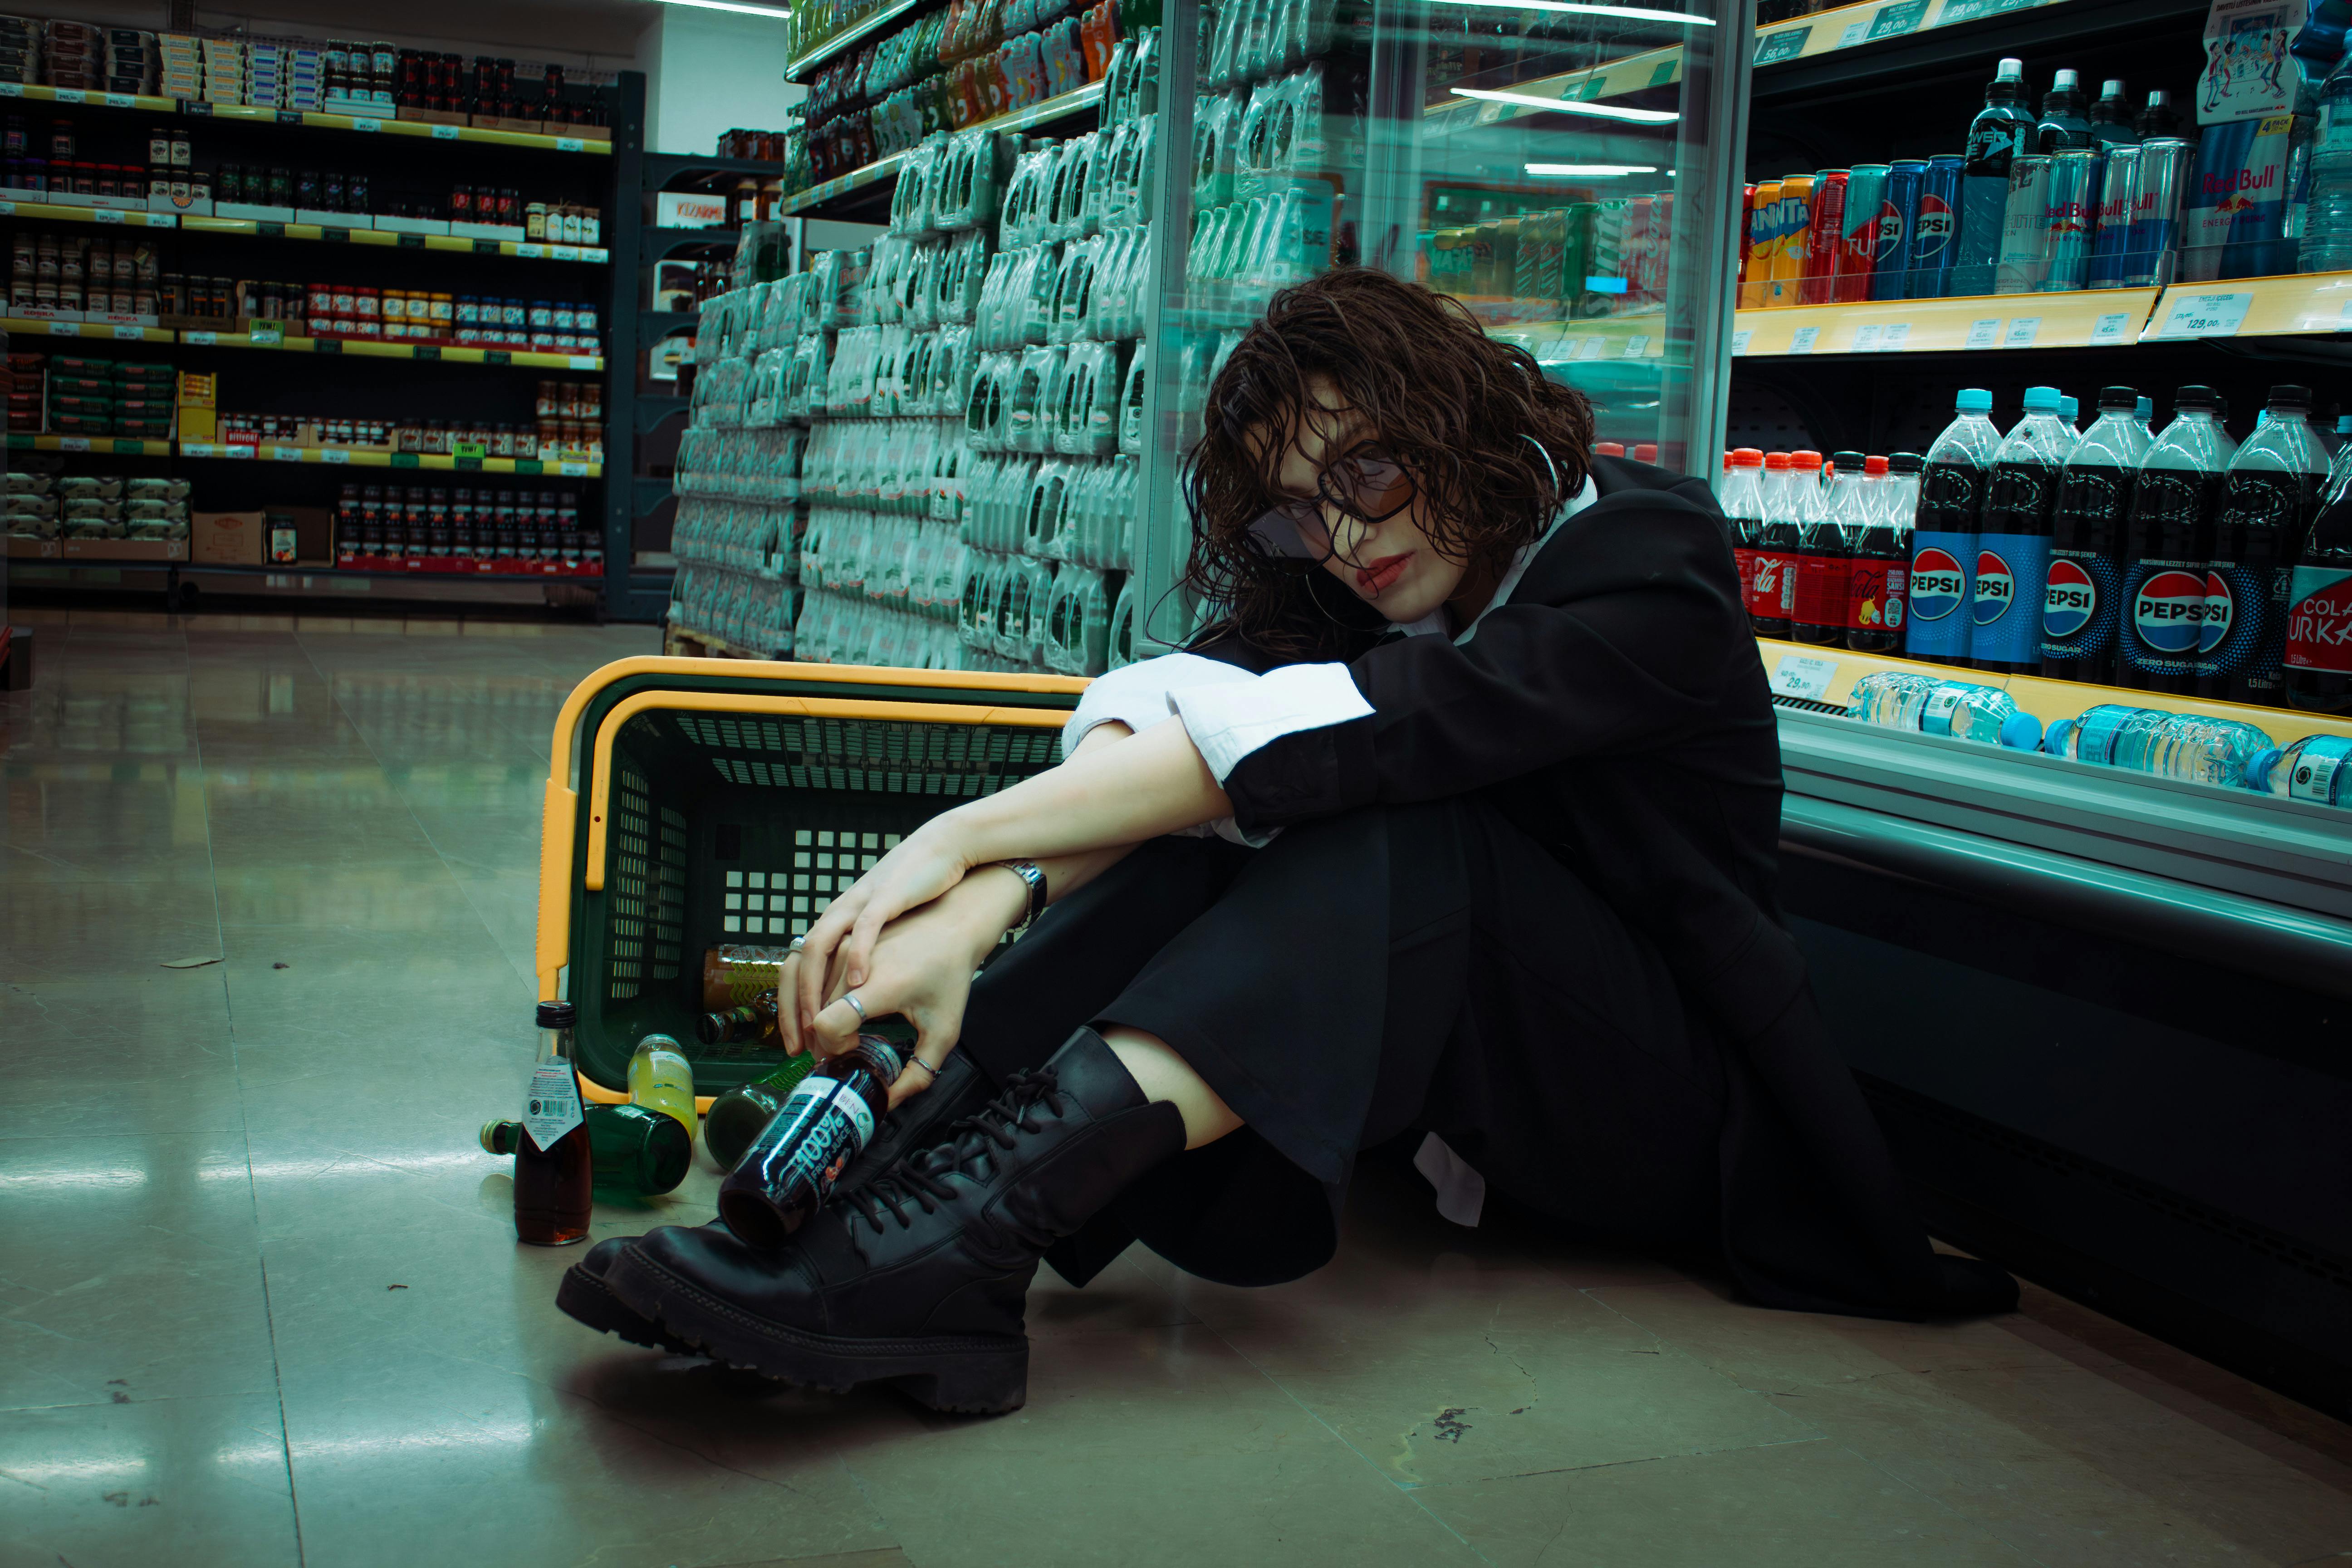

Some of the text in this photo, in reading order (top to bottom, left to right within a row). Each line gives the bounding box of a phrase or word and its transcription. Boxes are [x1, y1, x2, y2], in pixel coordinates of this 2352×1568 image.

[2262, 122, 2271, 132] 4
[2203, 165, 2274, 194] Red Bull
[677, 202, 725, 220] KIZARMI
[2203, 218, 2236, 227] ENERGY
[1911, 576, 1960, 593] PEPSI
[2046, 590, 2090, 608] EPSI
[2289, 615, 2352, 645] URKA
[2052, 645, 2081, 653] SUGAR
[2136, 658, 2163, 666] ZERO
[795, 1112, 845, 1169] 100%
[831, 1125, 853, 1154] JUICE
[811, 1152, 833, 1180] FRUIT
